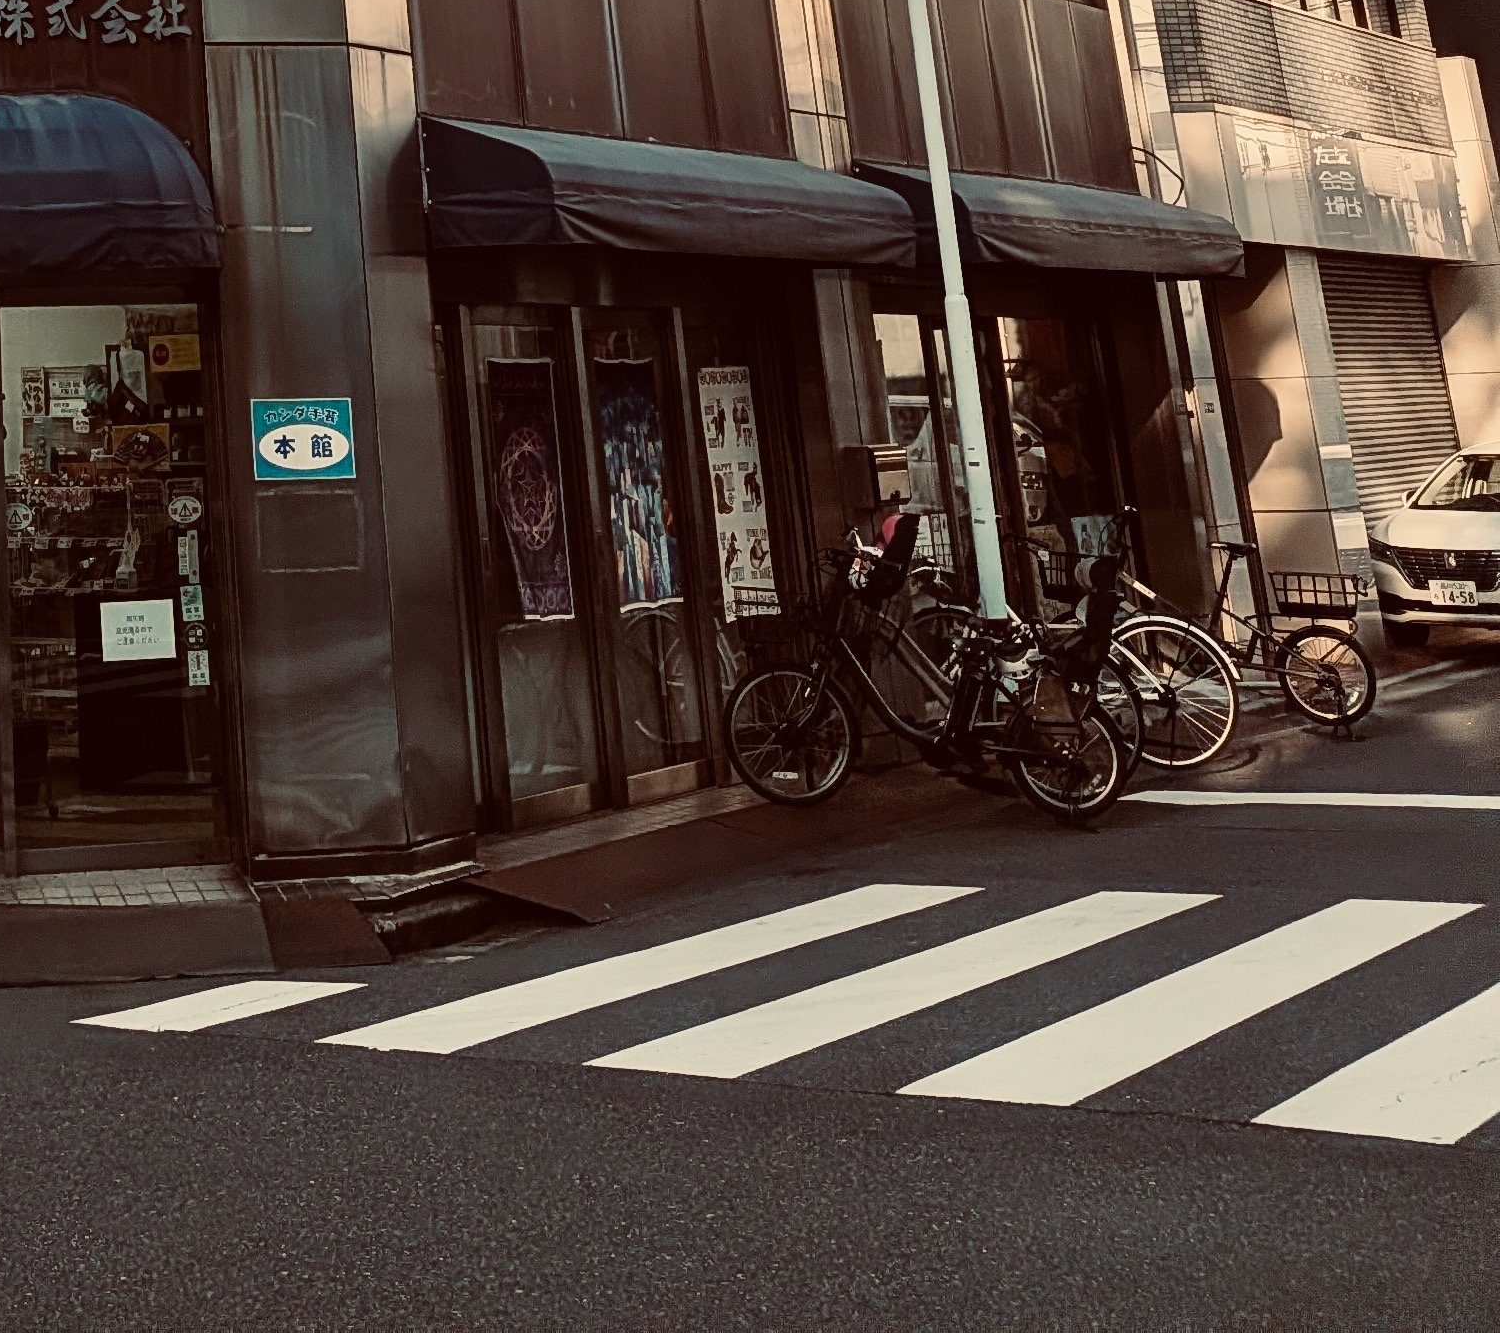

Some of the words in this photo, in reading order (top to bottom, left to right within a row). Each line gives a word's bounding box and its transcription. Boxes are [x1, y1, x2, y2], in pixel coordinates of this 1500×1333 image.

[263, 404, 340, 425] カンダ手芸
[273, 433, 334, 460] 本館
[1441, 590, 1476, 605] 14-58
